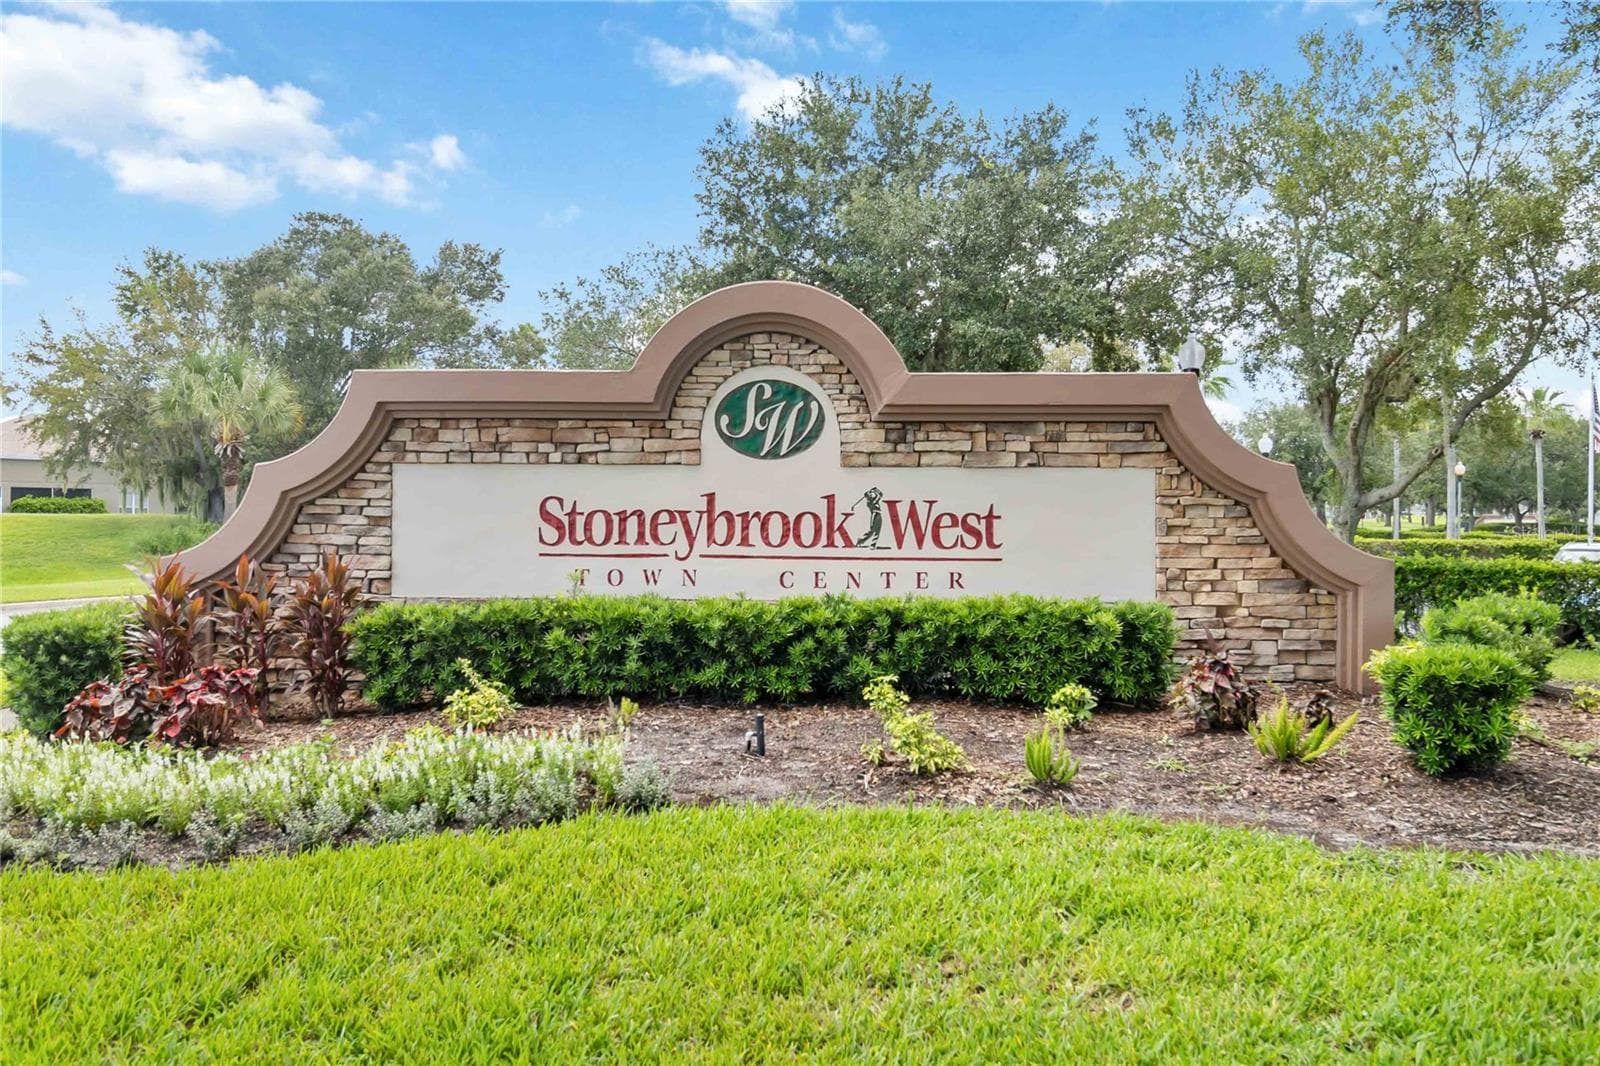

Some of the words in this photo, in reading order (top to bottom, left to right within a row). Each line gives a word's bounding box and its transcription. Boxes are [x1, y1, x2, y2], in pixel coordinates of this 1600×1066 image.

[720, 382, 819, 456] SW
[538, 492, 857, 561] Stoneybrook
[882, 499, 1003, 551] West
[574, 567, 698, 588] TOWN
[779, 569, 966, 590] CENTER
